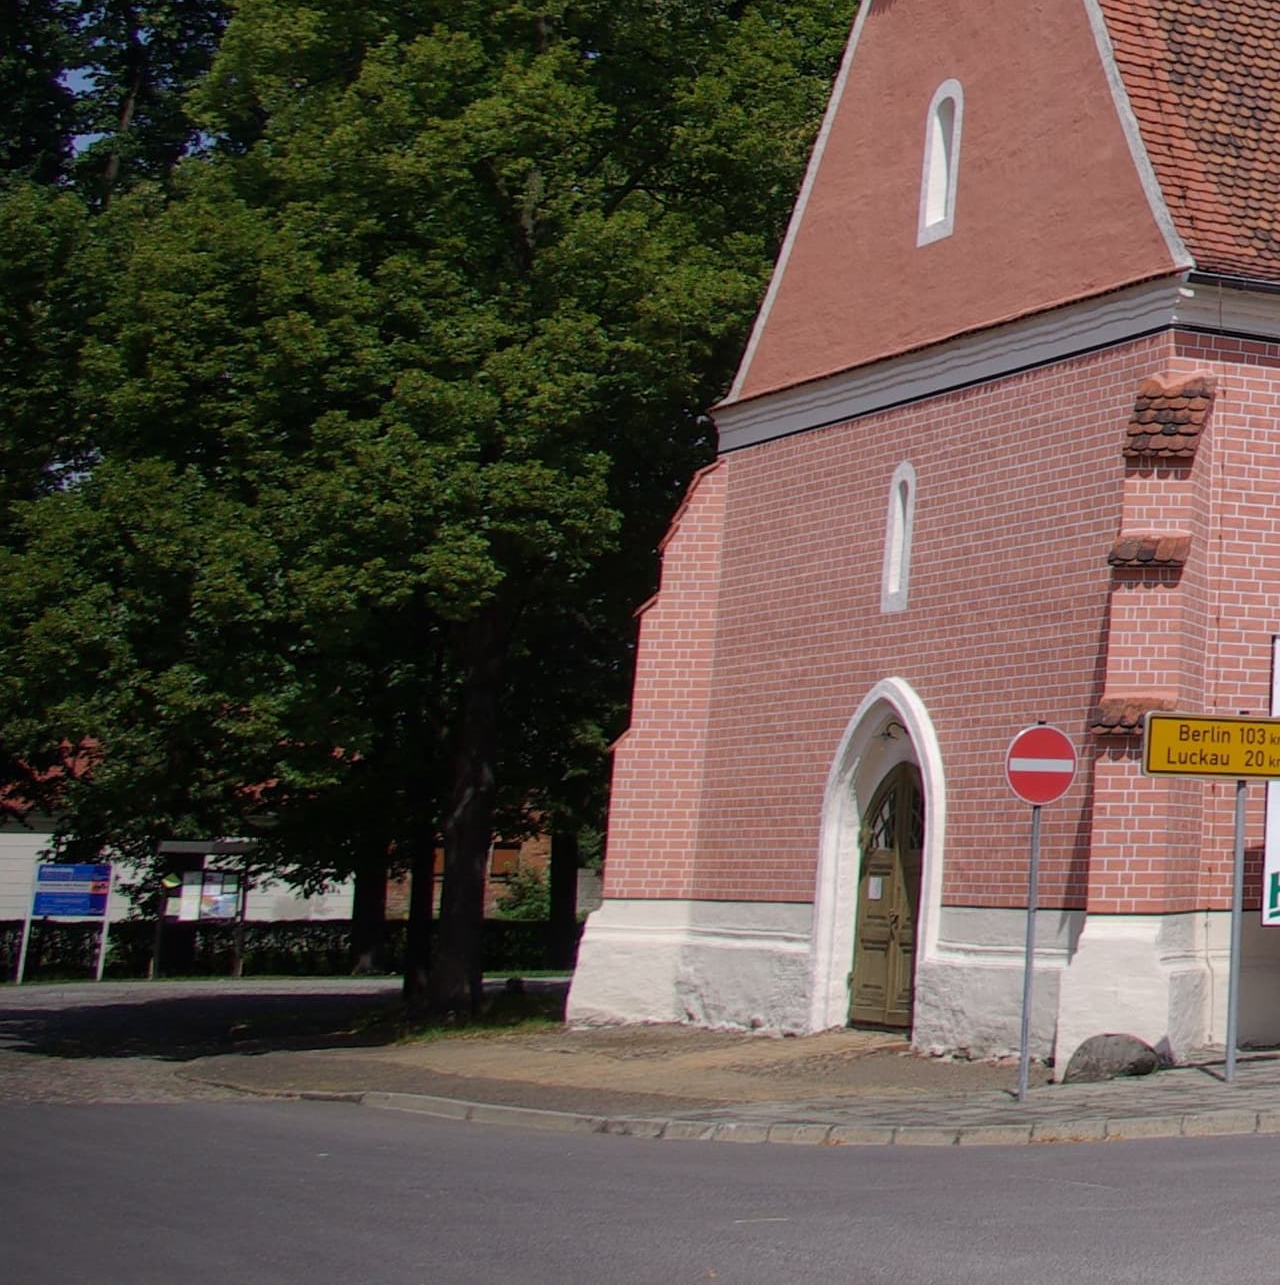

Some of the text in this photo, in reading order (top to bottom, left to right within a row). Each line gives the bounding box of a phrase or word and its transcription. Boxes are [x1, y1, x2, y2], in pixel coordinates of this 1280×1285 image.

[1178, 724, 1231, 744] Berlin
[1239, 727, 1266, 745] 103
[1167, 746, 1230, 766] Luckau
[1244, 750, 1265, 767] 20
